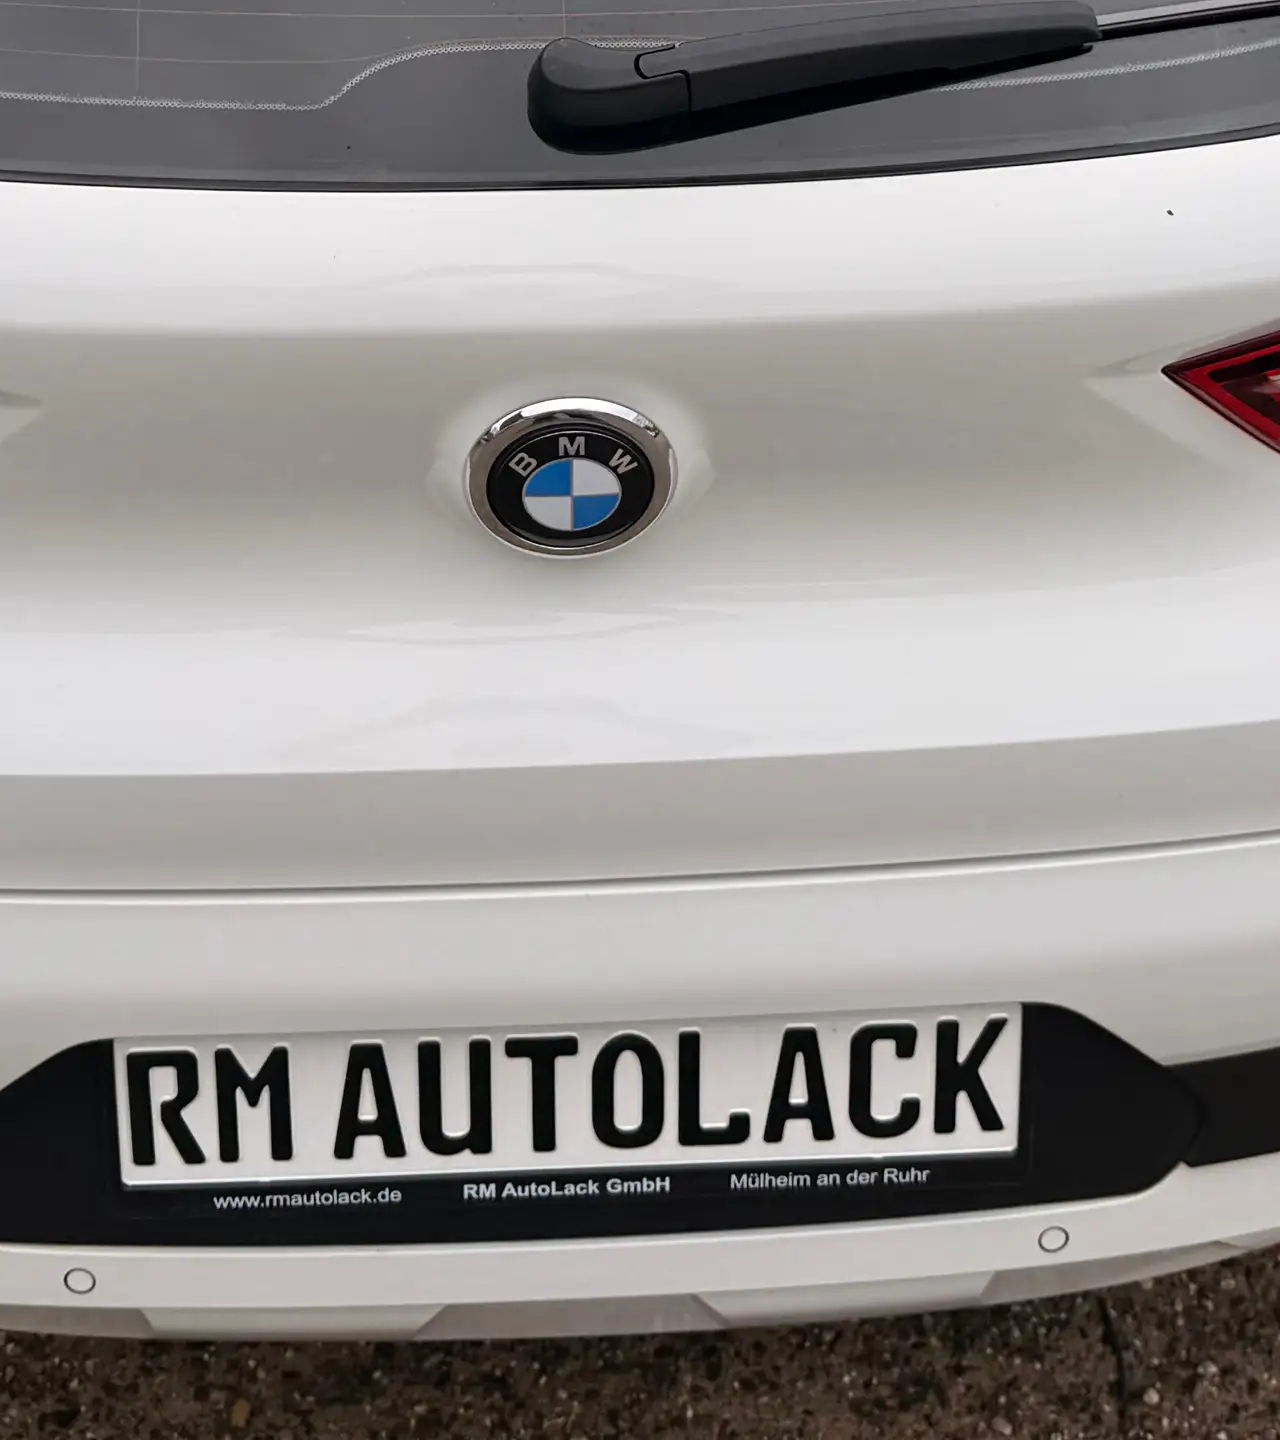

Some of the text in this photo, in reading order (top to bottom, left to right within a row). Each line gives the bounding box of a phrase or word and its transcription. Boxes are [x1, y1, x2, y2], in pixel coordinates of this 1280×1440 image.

[508, 435, 638, 477] BMW
[126, 1015, 1008, 1166] RM AUTOLACK
[462, 1175, 671, 1200] RM AutoLack GmbH
[730, 1167, 931, 1190] Mülheim an der Ruhr
[213, 1186, 403, 1210] www.rmautolack.de
